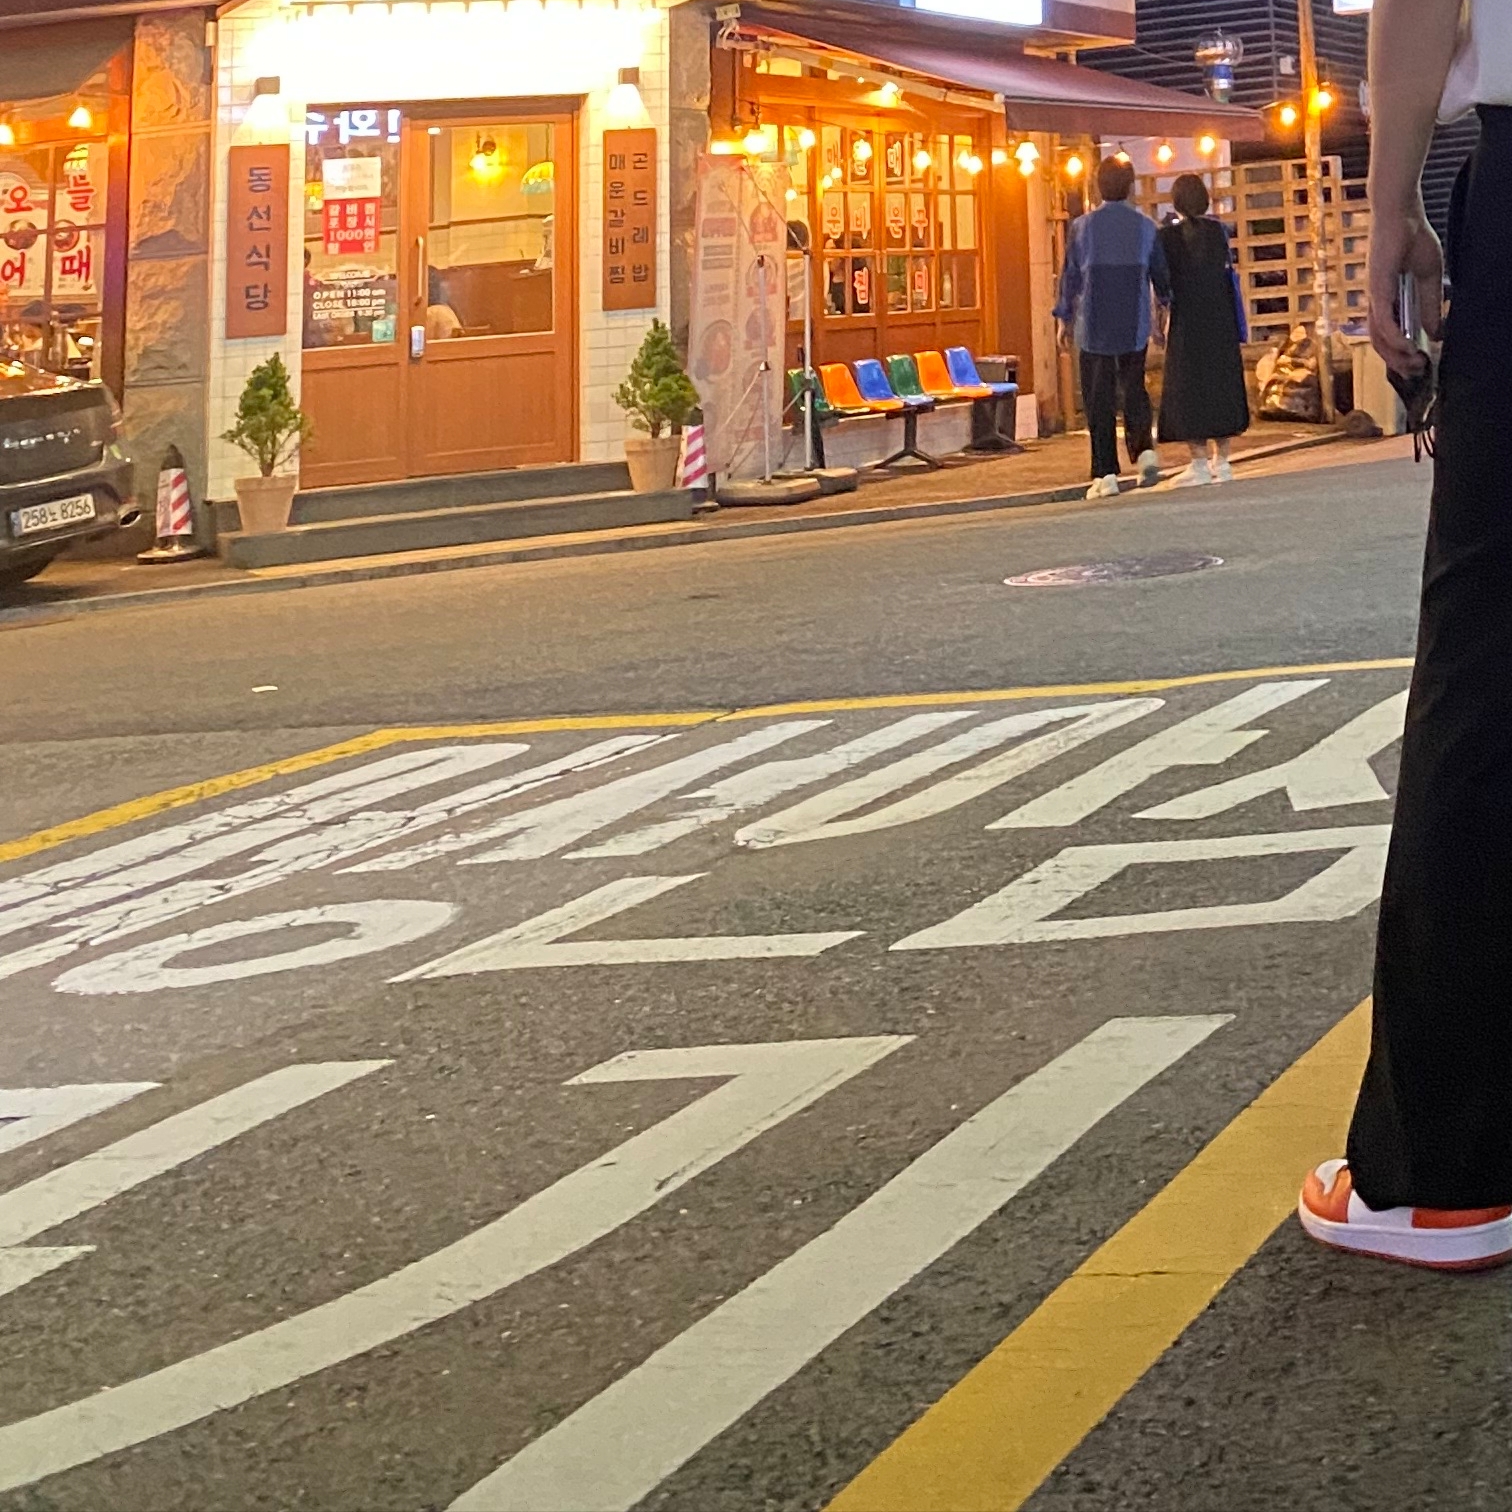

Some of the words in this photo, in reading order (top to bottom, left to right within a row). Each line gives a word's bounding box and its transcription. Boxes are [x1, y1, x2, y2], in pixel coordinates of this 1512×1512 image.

[246, 165, 273, 311] 동선식당
[608, 152, 626, 286] 매운갈비찜
[631, 151, 650, 284] 곤드레밥
[312, 290, 344, 299] OPEN
